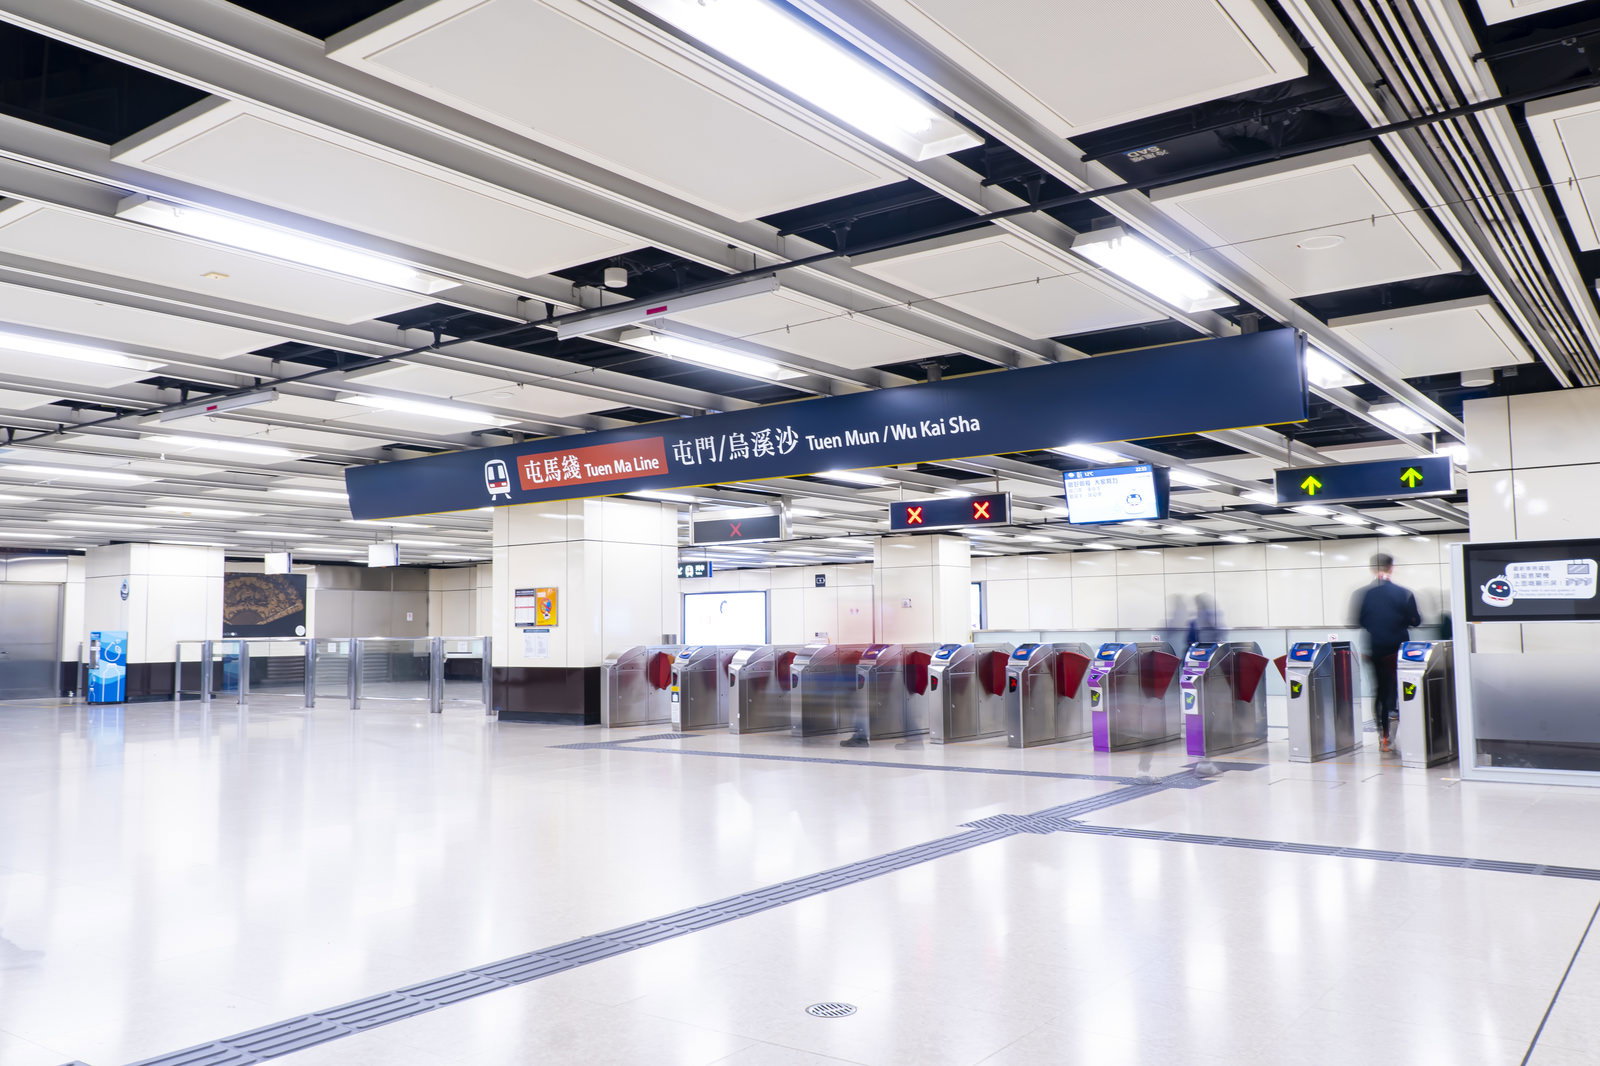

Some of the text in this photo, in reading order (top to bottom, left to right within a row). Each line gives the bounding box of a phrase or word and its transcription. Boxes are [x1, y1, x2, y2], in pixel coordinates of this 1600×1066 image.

[671, 427, 799, 466] 屯門/烏溪沙
[804, 434, 843, 451] Tuen
[844, 429, 880, 447] Mun
[889, 423, 918, 441] Wu
[919, 417, 946, 438] Kai
[948, 415, 981, 434] Sha
[523, 453, 583, 484] 屯馬綫
[583, 456, 660, 478] Tuen Ma Line
